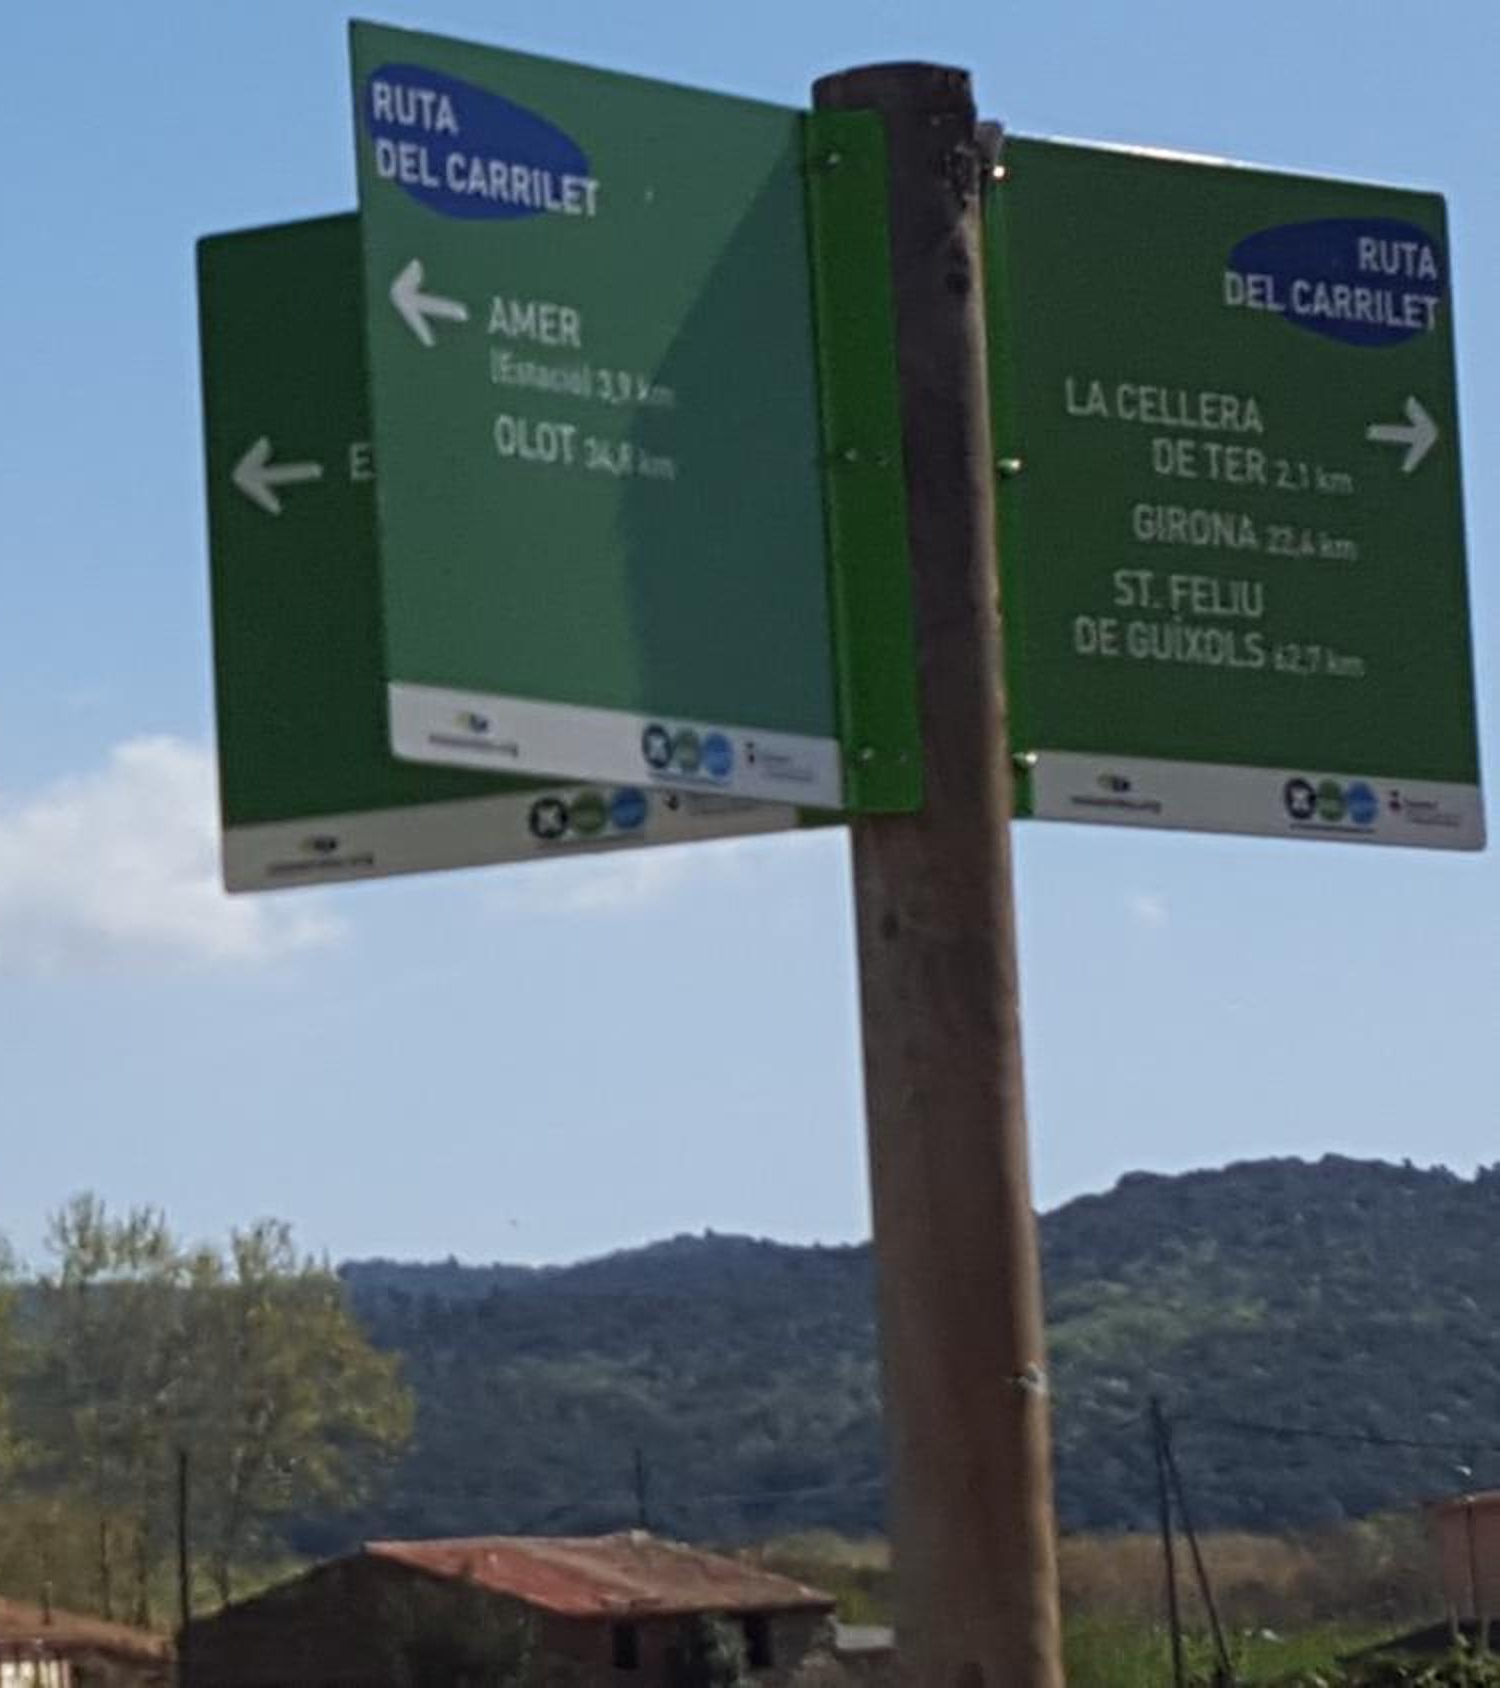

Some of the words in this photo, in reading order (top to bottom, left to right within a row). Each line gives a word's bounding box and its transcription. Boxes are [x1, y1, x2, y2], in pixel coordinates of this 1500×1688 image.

[372, 80, 459, 135] RUTA
[375, 138, 440, 190] DEL
[445, 151, 600, 218] CARRILET
[1357, 235, 1439, 280] RUTA
[487, 296, 582, 348] AMER
[1224, 271, 1286, 312] DEL
[1291, 280, 1440, 332] CARRILET
[1064, 376, 1110, 418] LA
[1115, 383, 1265, 433] CELLERA
[493, 413, 578, 465] OLOT
[1152, 437, 1198, 478] DE
[1201, 441, 1269, 486] TER
[1315, 465, 1354, 494] km
[1132, 502, 1258, 549] GIRONA
[1318, 530, 1359, 561] km
[1112, 568, 1162, 609] ST.
[1170, 573, 1265, 618] FELIU
[1074, 614, 1119, 656] DE
[1127, 613, 1265, 668] GUÍXOLS
[1325, 648, 1366, 678] km
